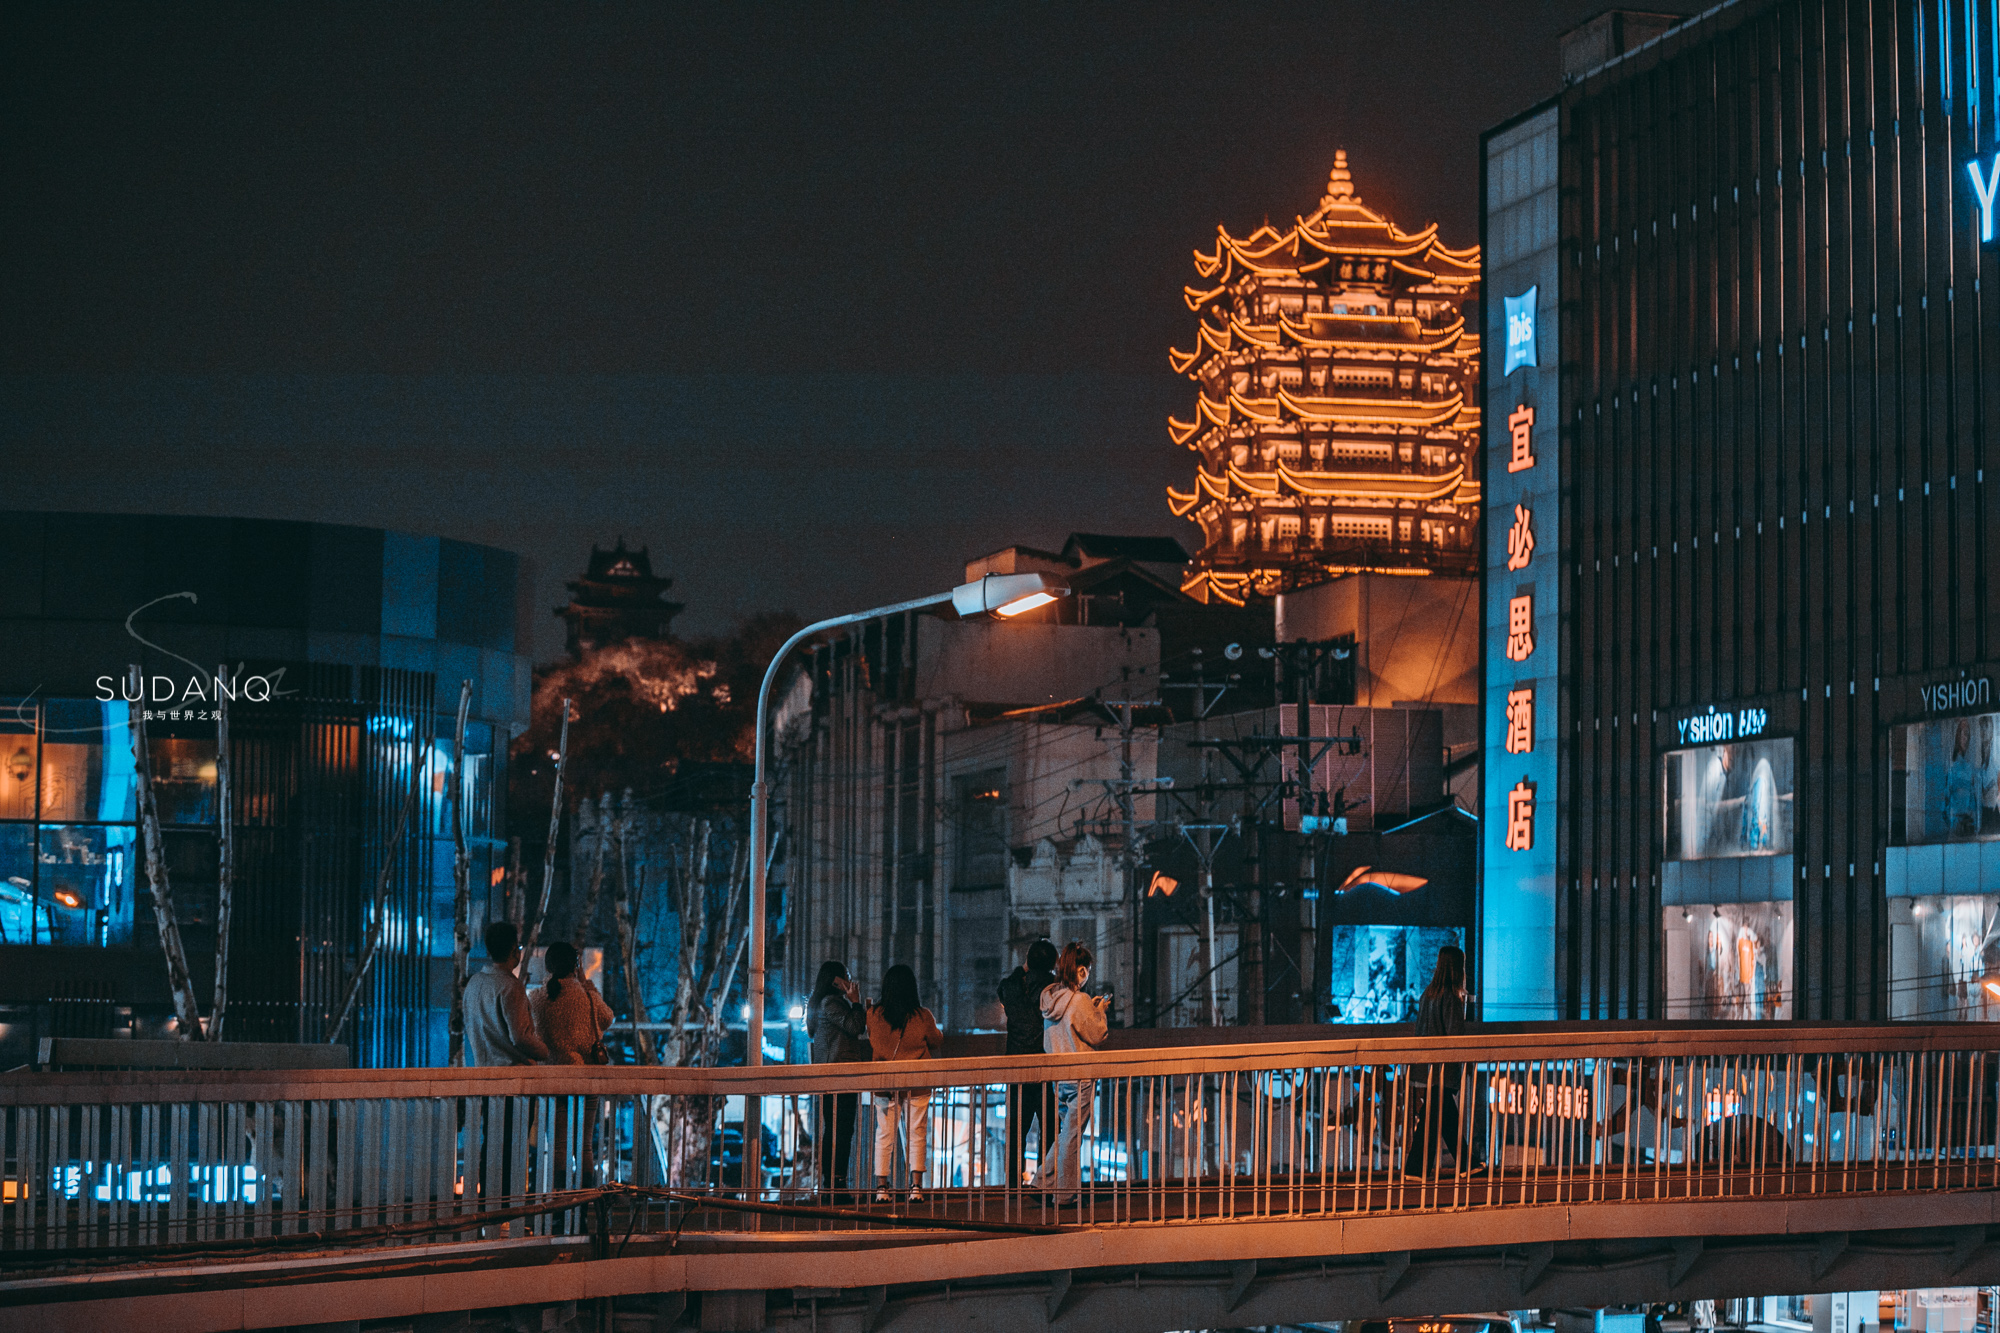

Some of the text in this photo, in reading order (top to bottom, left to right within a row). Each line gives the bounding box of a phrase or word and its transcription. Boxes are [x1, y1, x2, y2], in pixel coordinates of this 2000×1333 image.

[1509, 311, 1532, 347] ibis
[1506, 404, 1535, 851] 宜必思酒店
